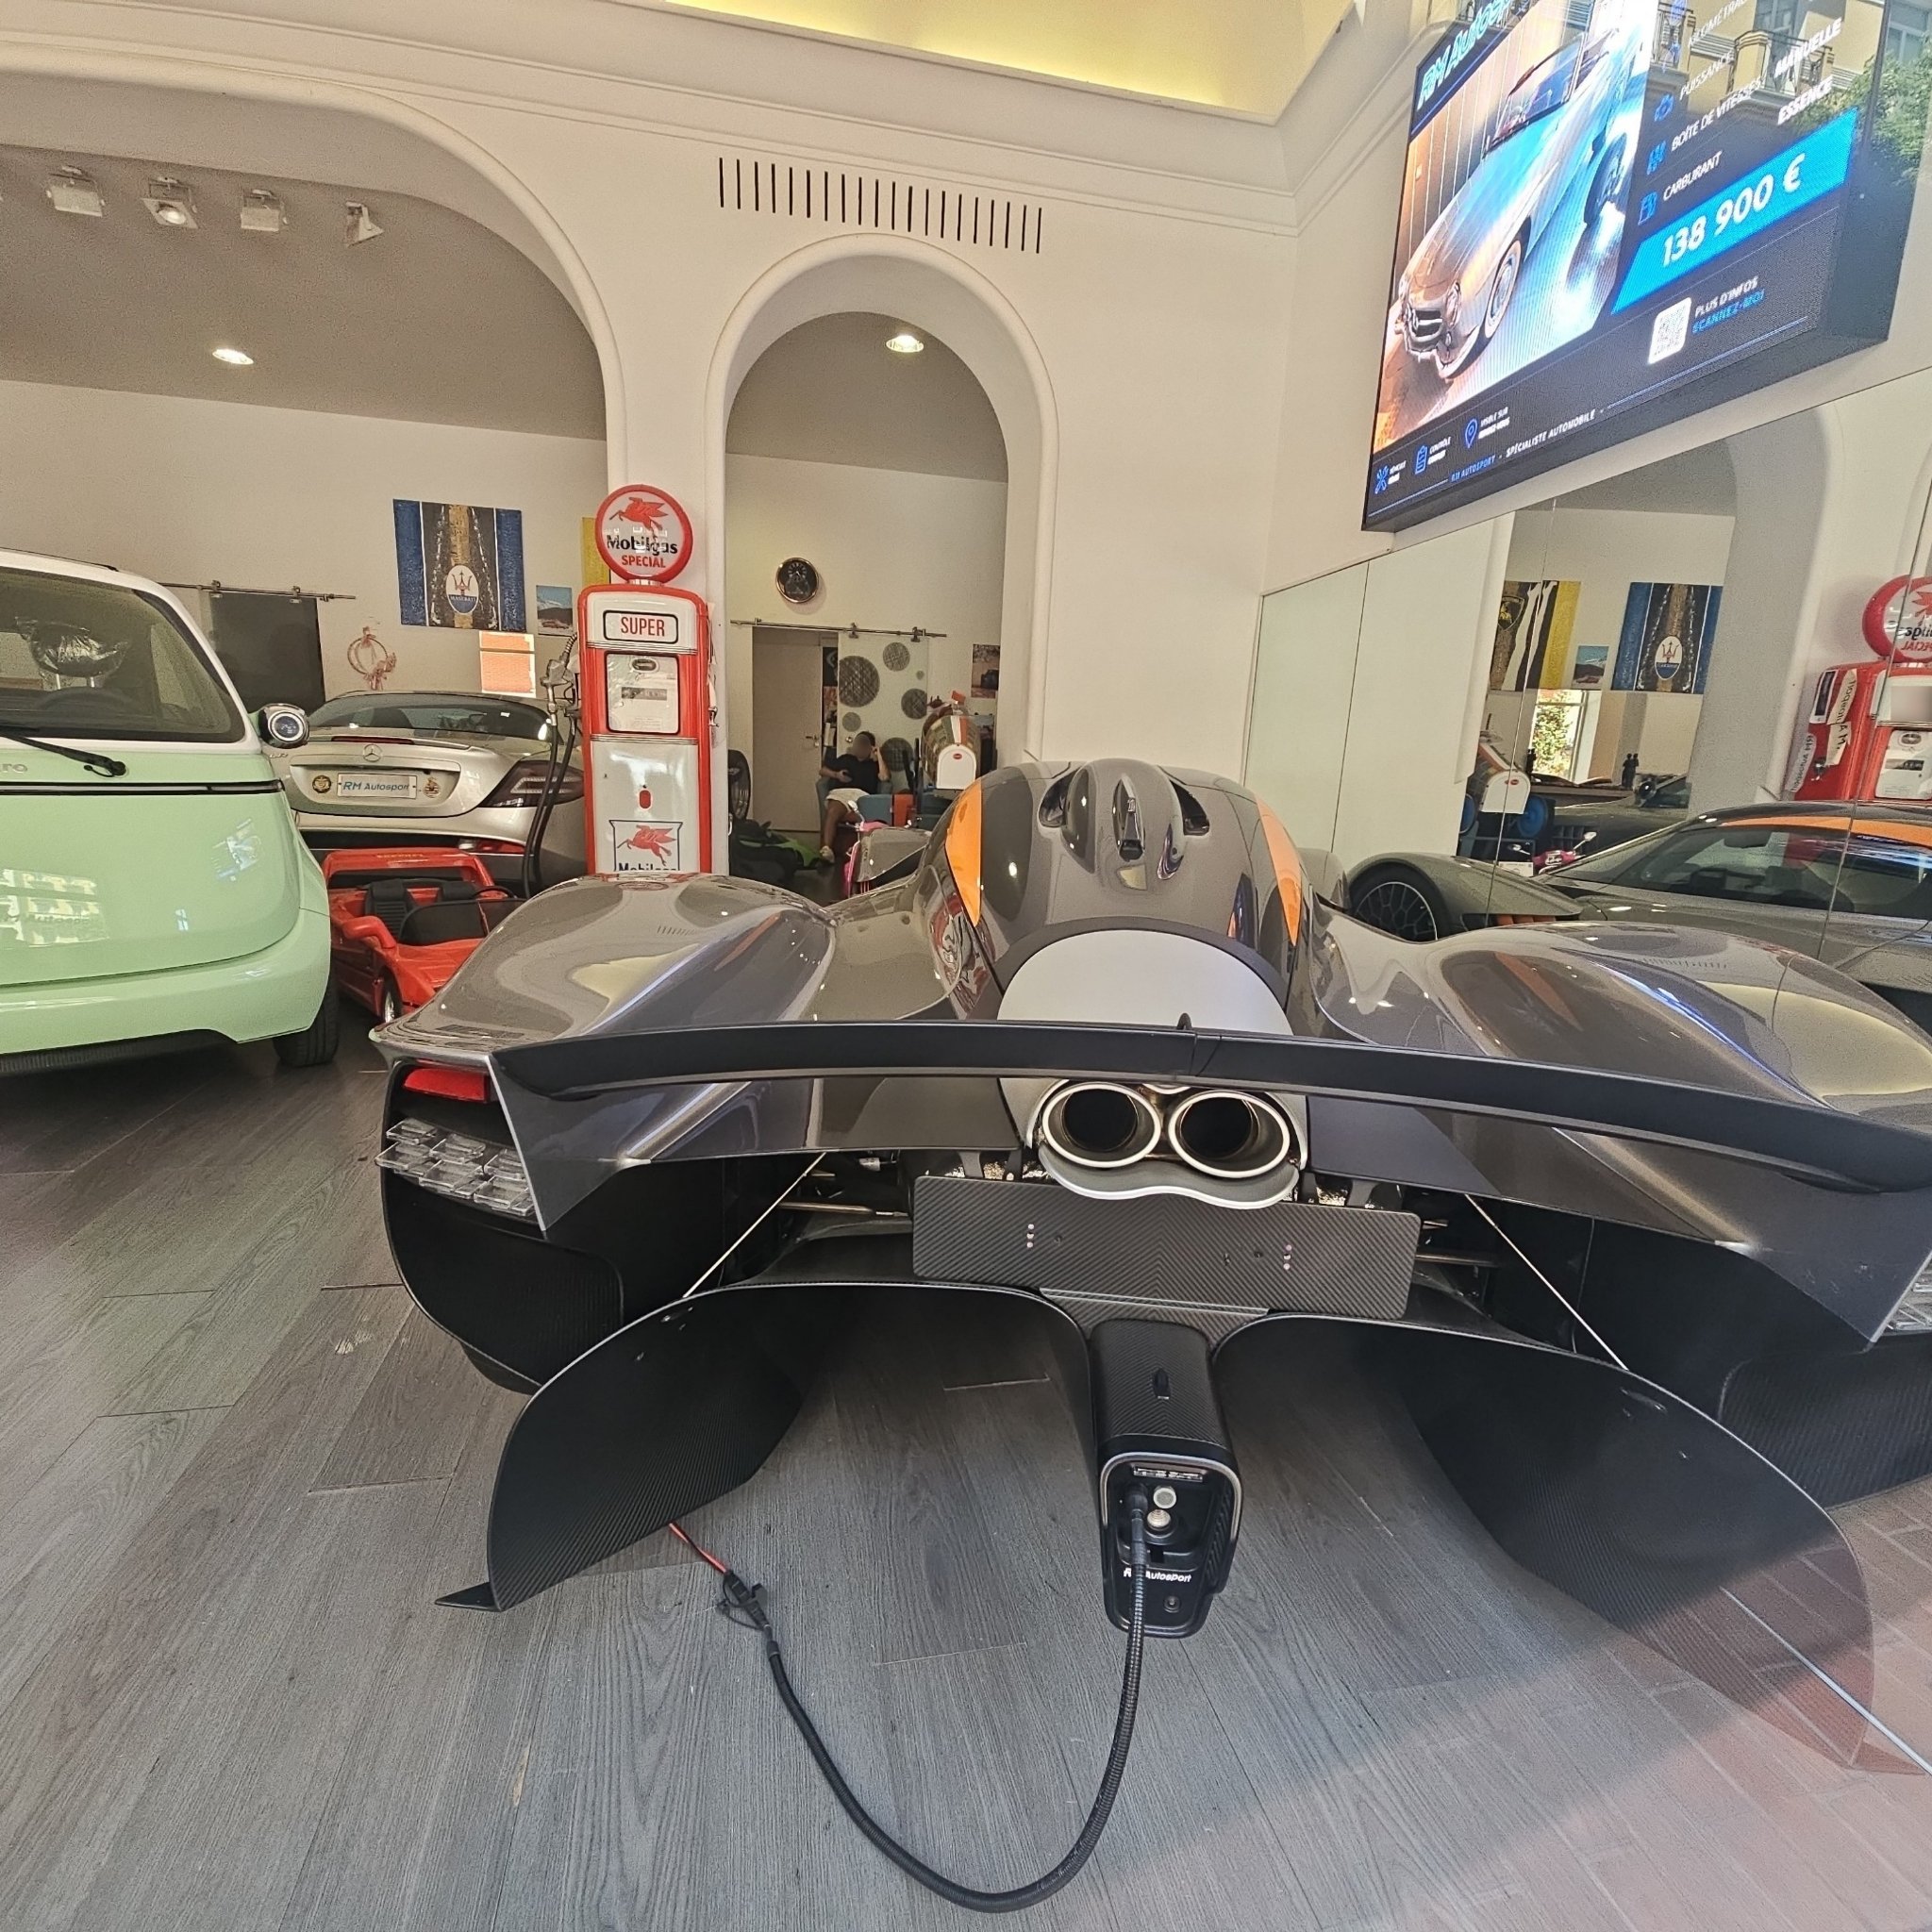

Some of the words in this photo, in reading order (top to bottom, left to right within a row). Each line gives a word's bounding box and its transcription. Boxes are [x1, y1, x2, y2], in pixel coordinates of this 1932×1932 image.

[1777, 75, 1834, 125] ESSENCE
[1701, 108, 1715, 131] DE
[1663, 151, 1723, 201] CARBURANT
[1663, 215, 1707, 267] 138
[1714, 174, 1774, 236] 900
[1783, 153, 1807, 193] €
[1694, 296, 1719, 319] PLUS
[1548, 408, 1595, 438] AUTOMOBILE
[1461, 454, 1496, 477] AUTOSPORT
[607, 535, 678, 557] Mobilgas
[622, 555, 666, 568] SPECIAL
[621, 616, 665, 637] SUPER
[343, 781, 362, 791] RM
[364, 782, 410, 793] Autosport
